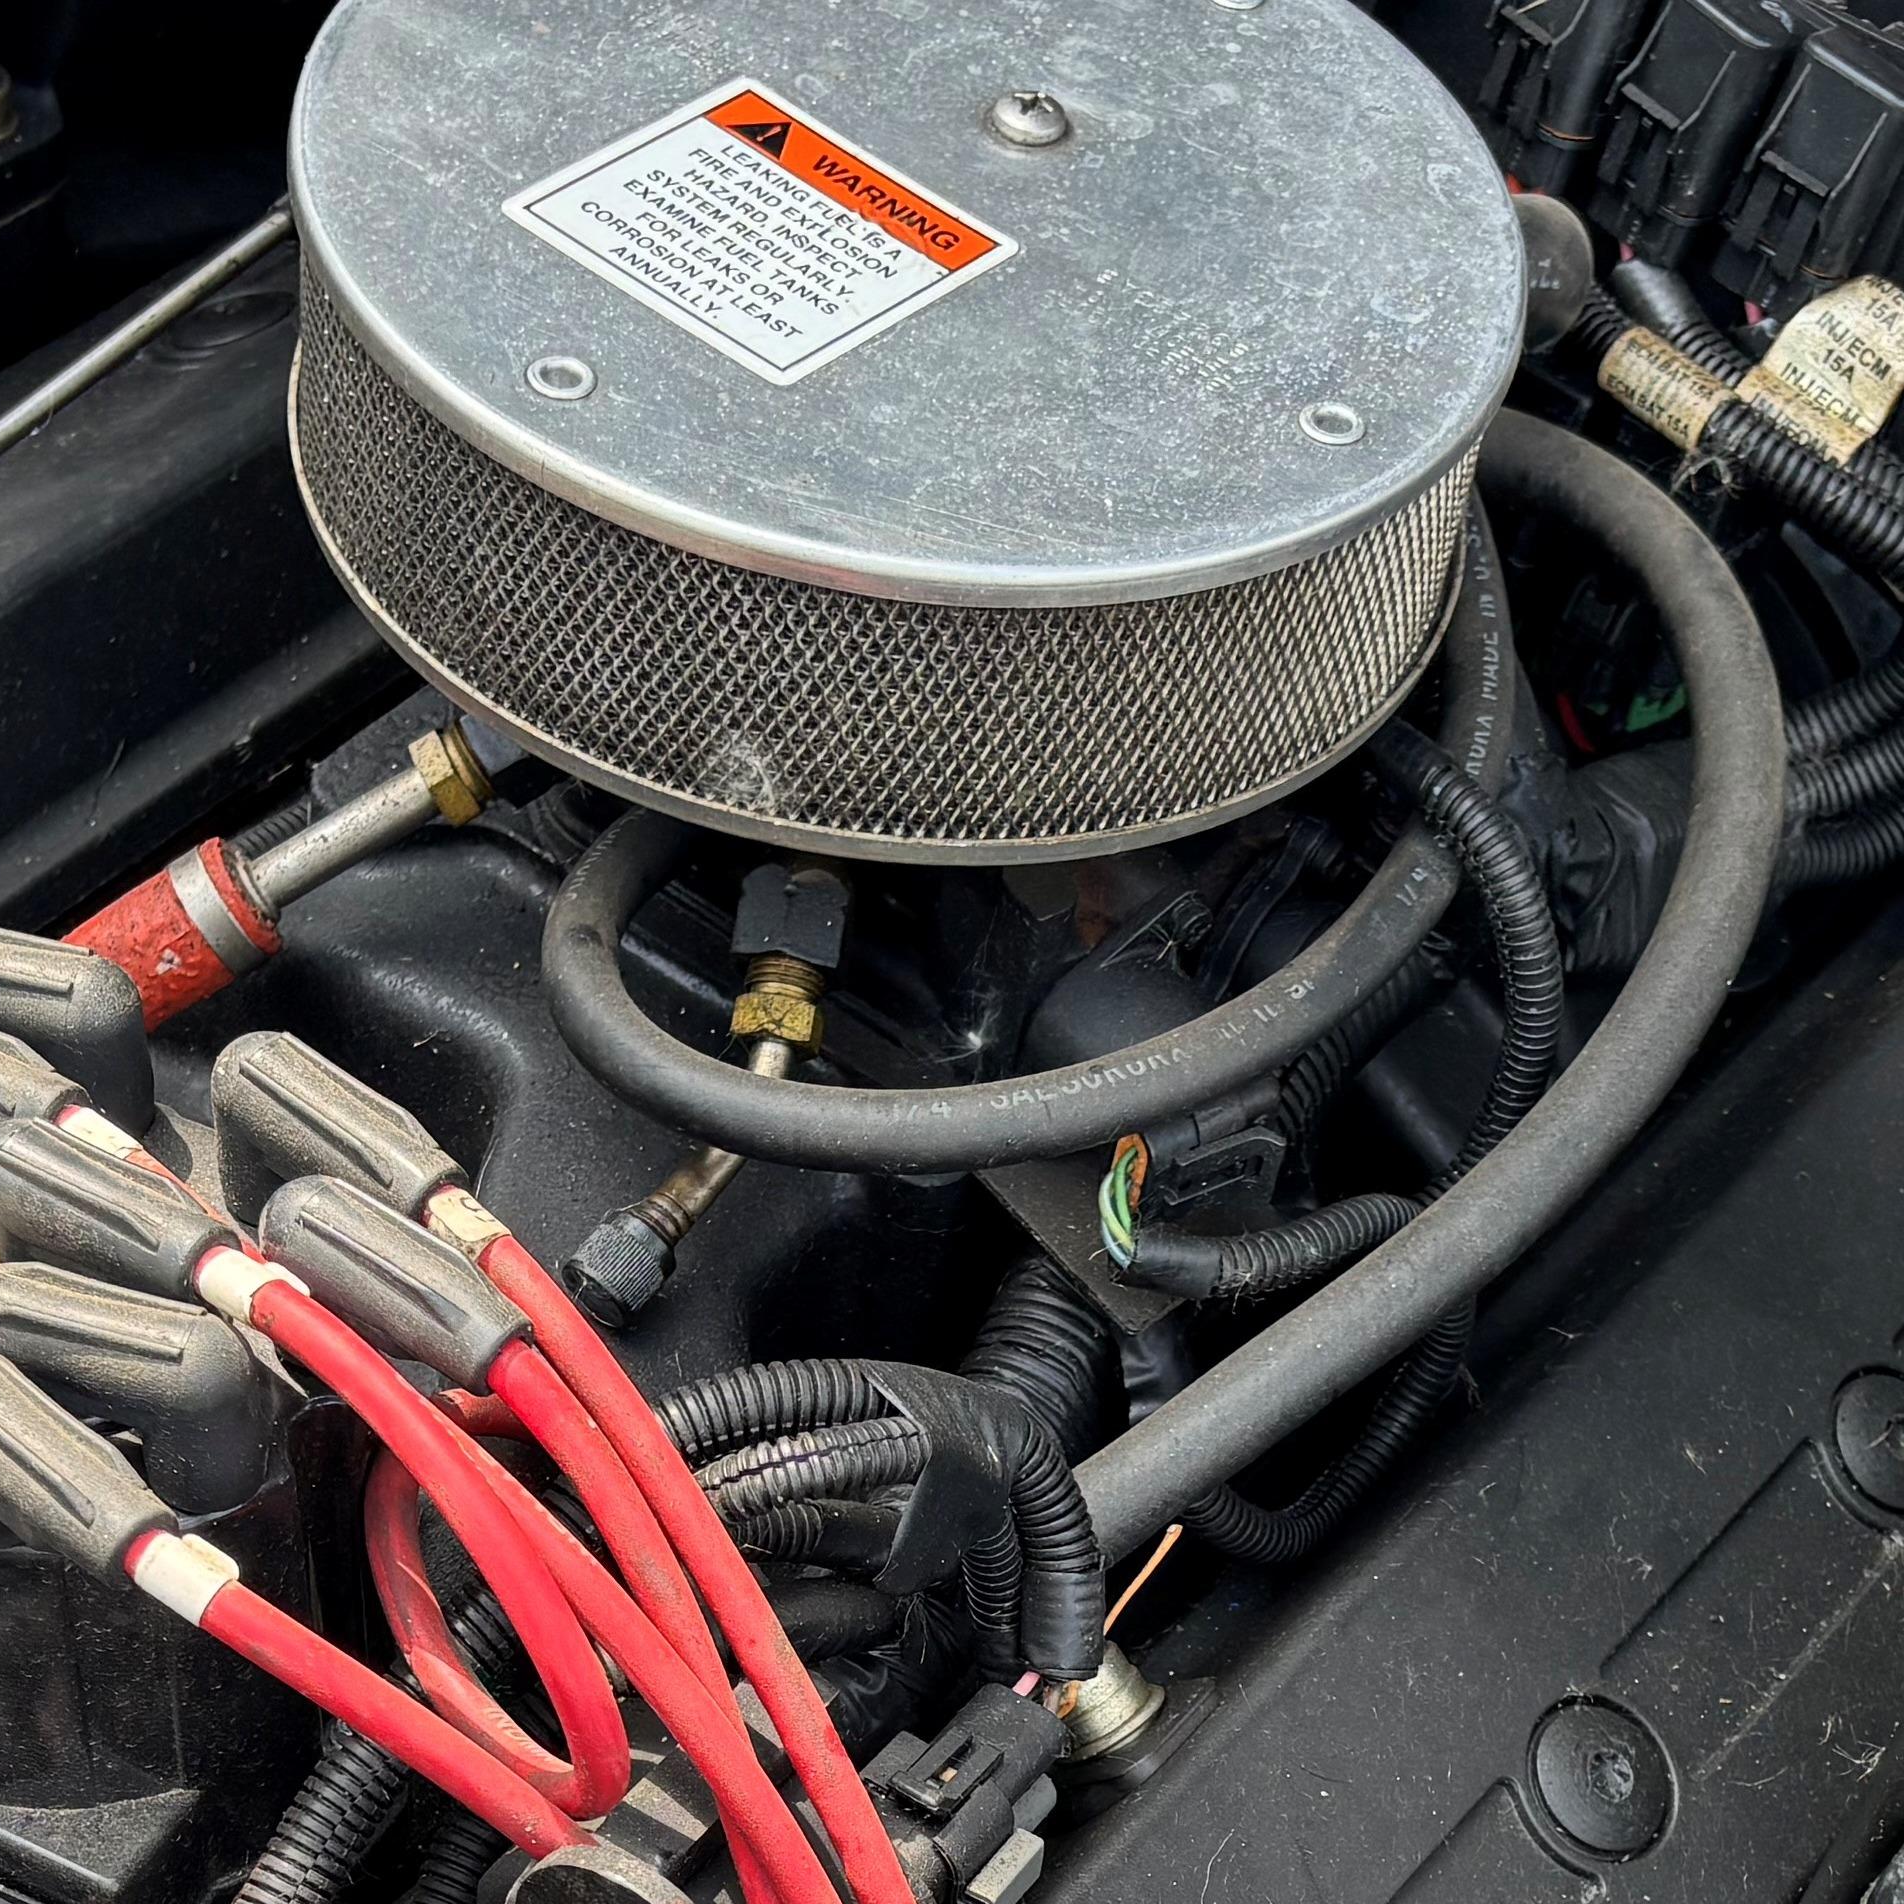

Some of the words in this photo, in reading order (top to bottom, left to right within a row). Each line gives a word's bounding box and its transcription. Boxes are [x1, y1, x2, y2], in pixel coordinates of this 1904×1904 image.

[688, 148, 739, 180] FIRE
[734, 180, 782, 208] AND
[720, 144, 811, 203] LEAKING
[809, 200, 857, 235] FUEL
[884, 248, 902, 263] A
[812, 155, 960, 251] WARNING
[580, 201, 703, 279] CORROSION
[699, 278, 734, 297] AT
[729, 295, 804, 338] LEAST
[623, 178, 716, 239] EXAMINE
[713, 235, 766, 272] FUEL
[769, 268, 840, 315] TANKS
[635, 211, 682, 242] FOR
[681, 239, 752, 286] LEAKS
[750, 283, 784, 306] OR
[646, 169, 730, 224] SYSTEM
[727, 220, 855, 303] REGULARLY.
[771, 224, 863, 279] INSPECT
[608, 246, 723, 319] ANNUALLY.
[1865, 298, 1898, 331] 15A
[1816, 310, 1892, 380] INJ/ECM
[1823, 349, 1856, 384] 15A
[1607, 374, 1636, 400] ECM
[1637, 394, 1665, 419] BAT
[1667, 414, 1689, 438] 15A
[1779, 362, 1860, 427] INJ/ECM
